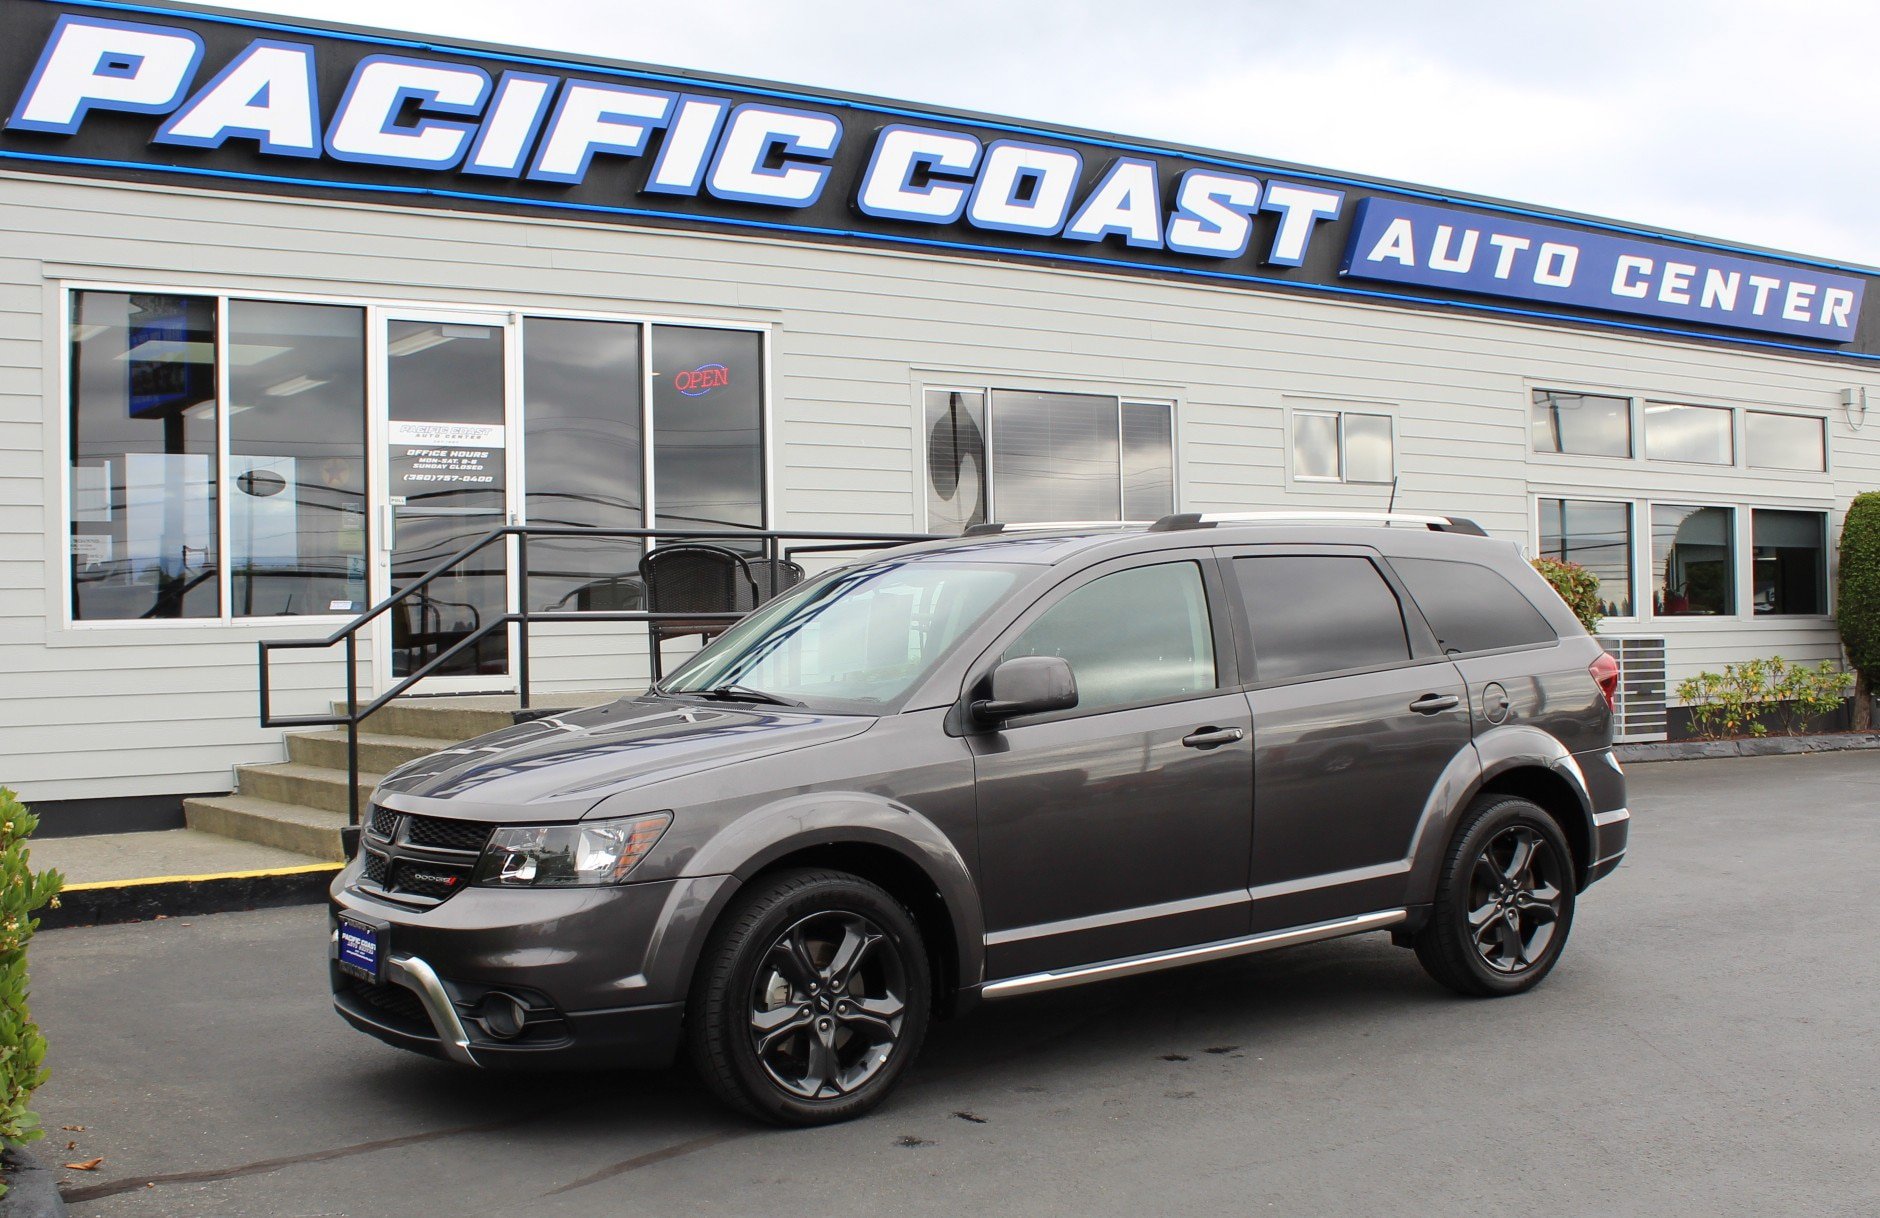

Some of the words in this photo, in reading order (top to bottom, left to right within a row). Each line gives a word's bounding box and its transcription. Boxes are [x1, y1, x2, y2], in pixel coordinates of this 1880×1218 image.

[5, 13, 843, 208] PACIFIC
[857, 124, 1346, 267] COAST
[1366, 217, 1580, 288] AUTO
[1610, 253, 1855, 329] CENTER
[674, 367, 729, 391] OPEN
[400, 425, 449, 434] PACIFIC
[450, 427, 492, 435] COAST
[406, 449, 447, 457] OFFICE
[415, 874, 450, 883] DODGE
[342, 932, 361, 945] PACIFIC
[361, 940, 376, 951] COAST
